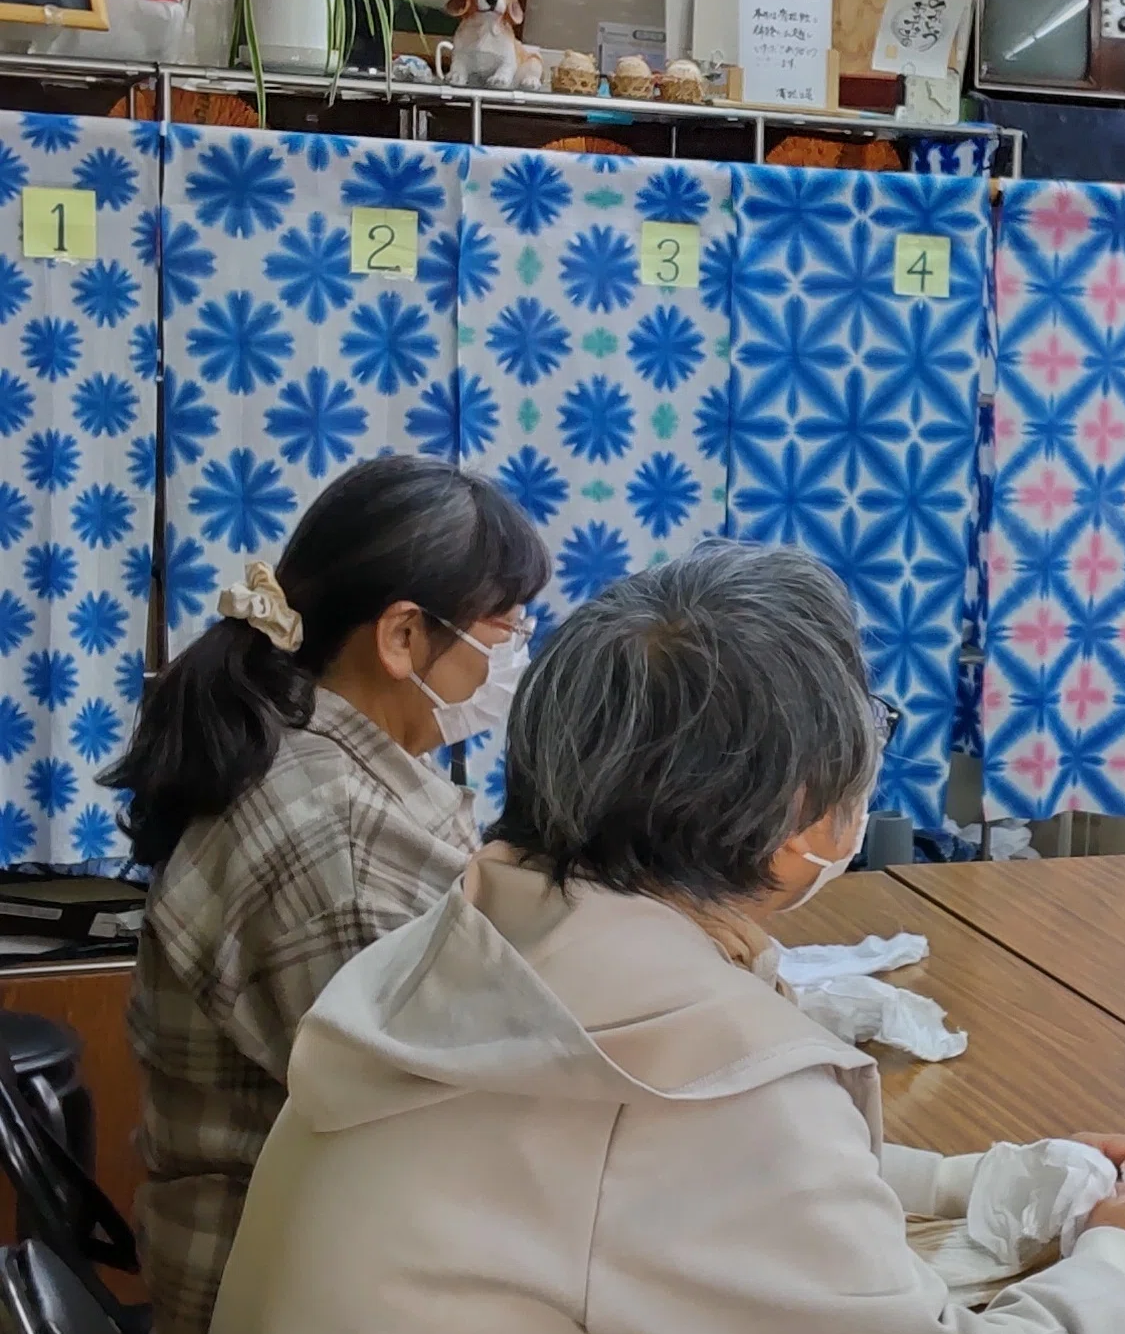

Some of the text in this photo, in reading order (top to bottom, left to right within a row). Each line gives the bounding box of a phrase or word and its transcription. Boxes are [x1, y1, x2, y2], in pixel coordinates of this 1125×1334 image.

[49, 203, 68, 252] 1
[366, 224, 401, 272] 2
[656, 238, 682, 283] 3
[906, 250, 934, 292] 4
